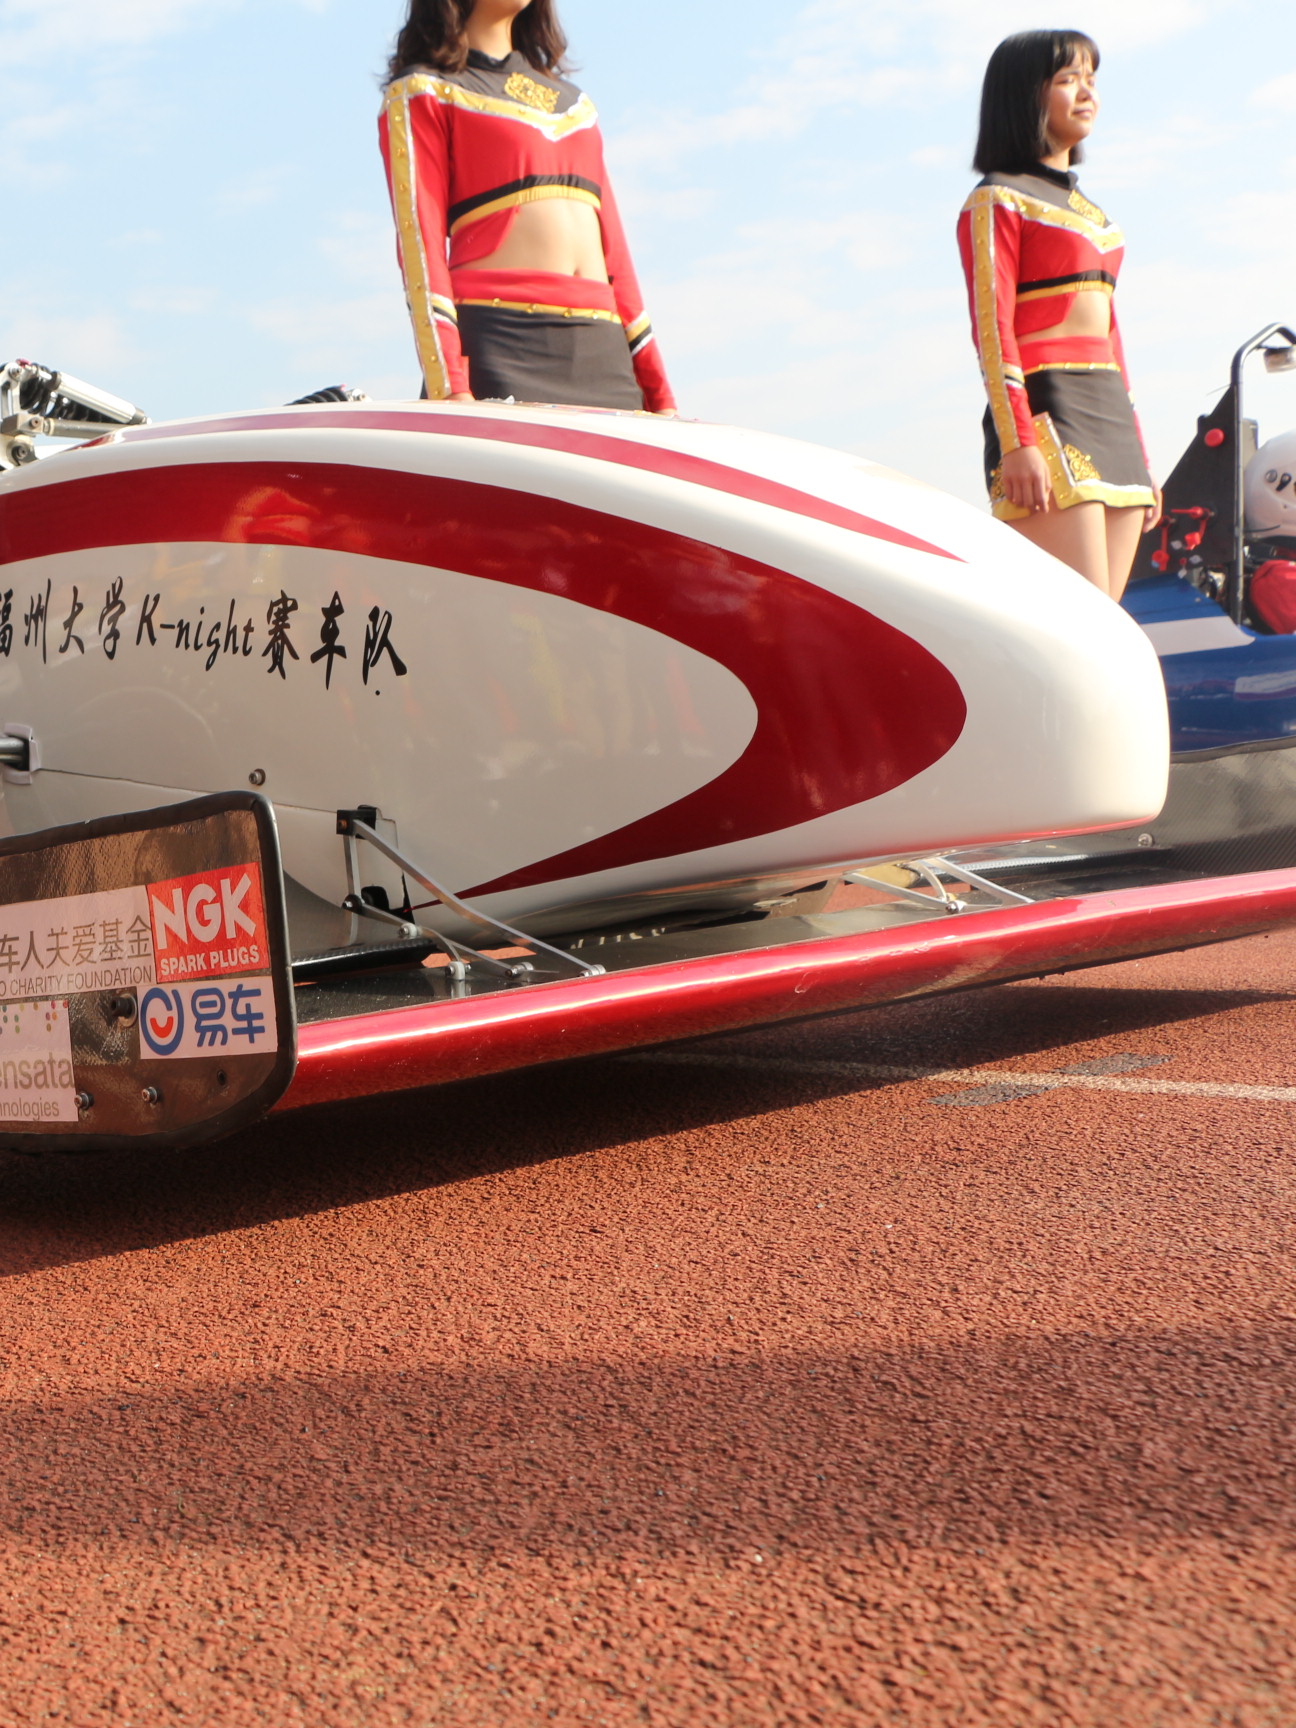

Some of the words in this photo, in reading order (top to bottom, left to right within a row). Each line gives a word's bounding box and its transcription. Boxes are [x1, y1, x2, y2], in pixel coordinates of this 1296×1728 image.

[152, 873, 257, 950] NGK
[10, 973, 63, 996] CHARITY
[67, 965, 152, 990] FOUNDATION
[160, 953, 207, 976] SPARK
[210, 945, 259, 969] PLUGS
[191, 984, 265, 1047] 易车
